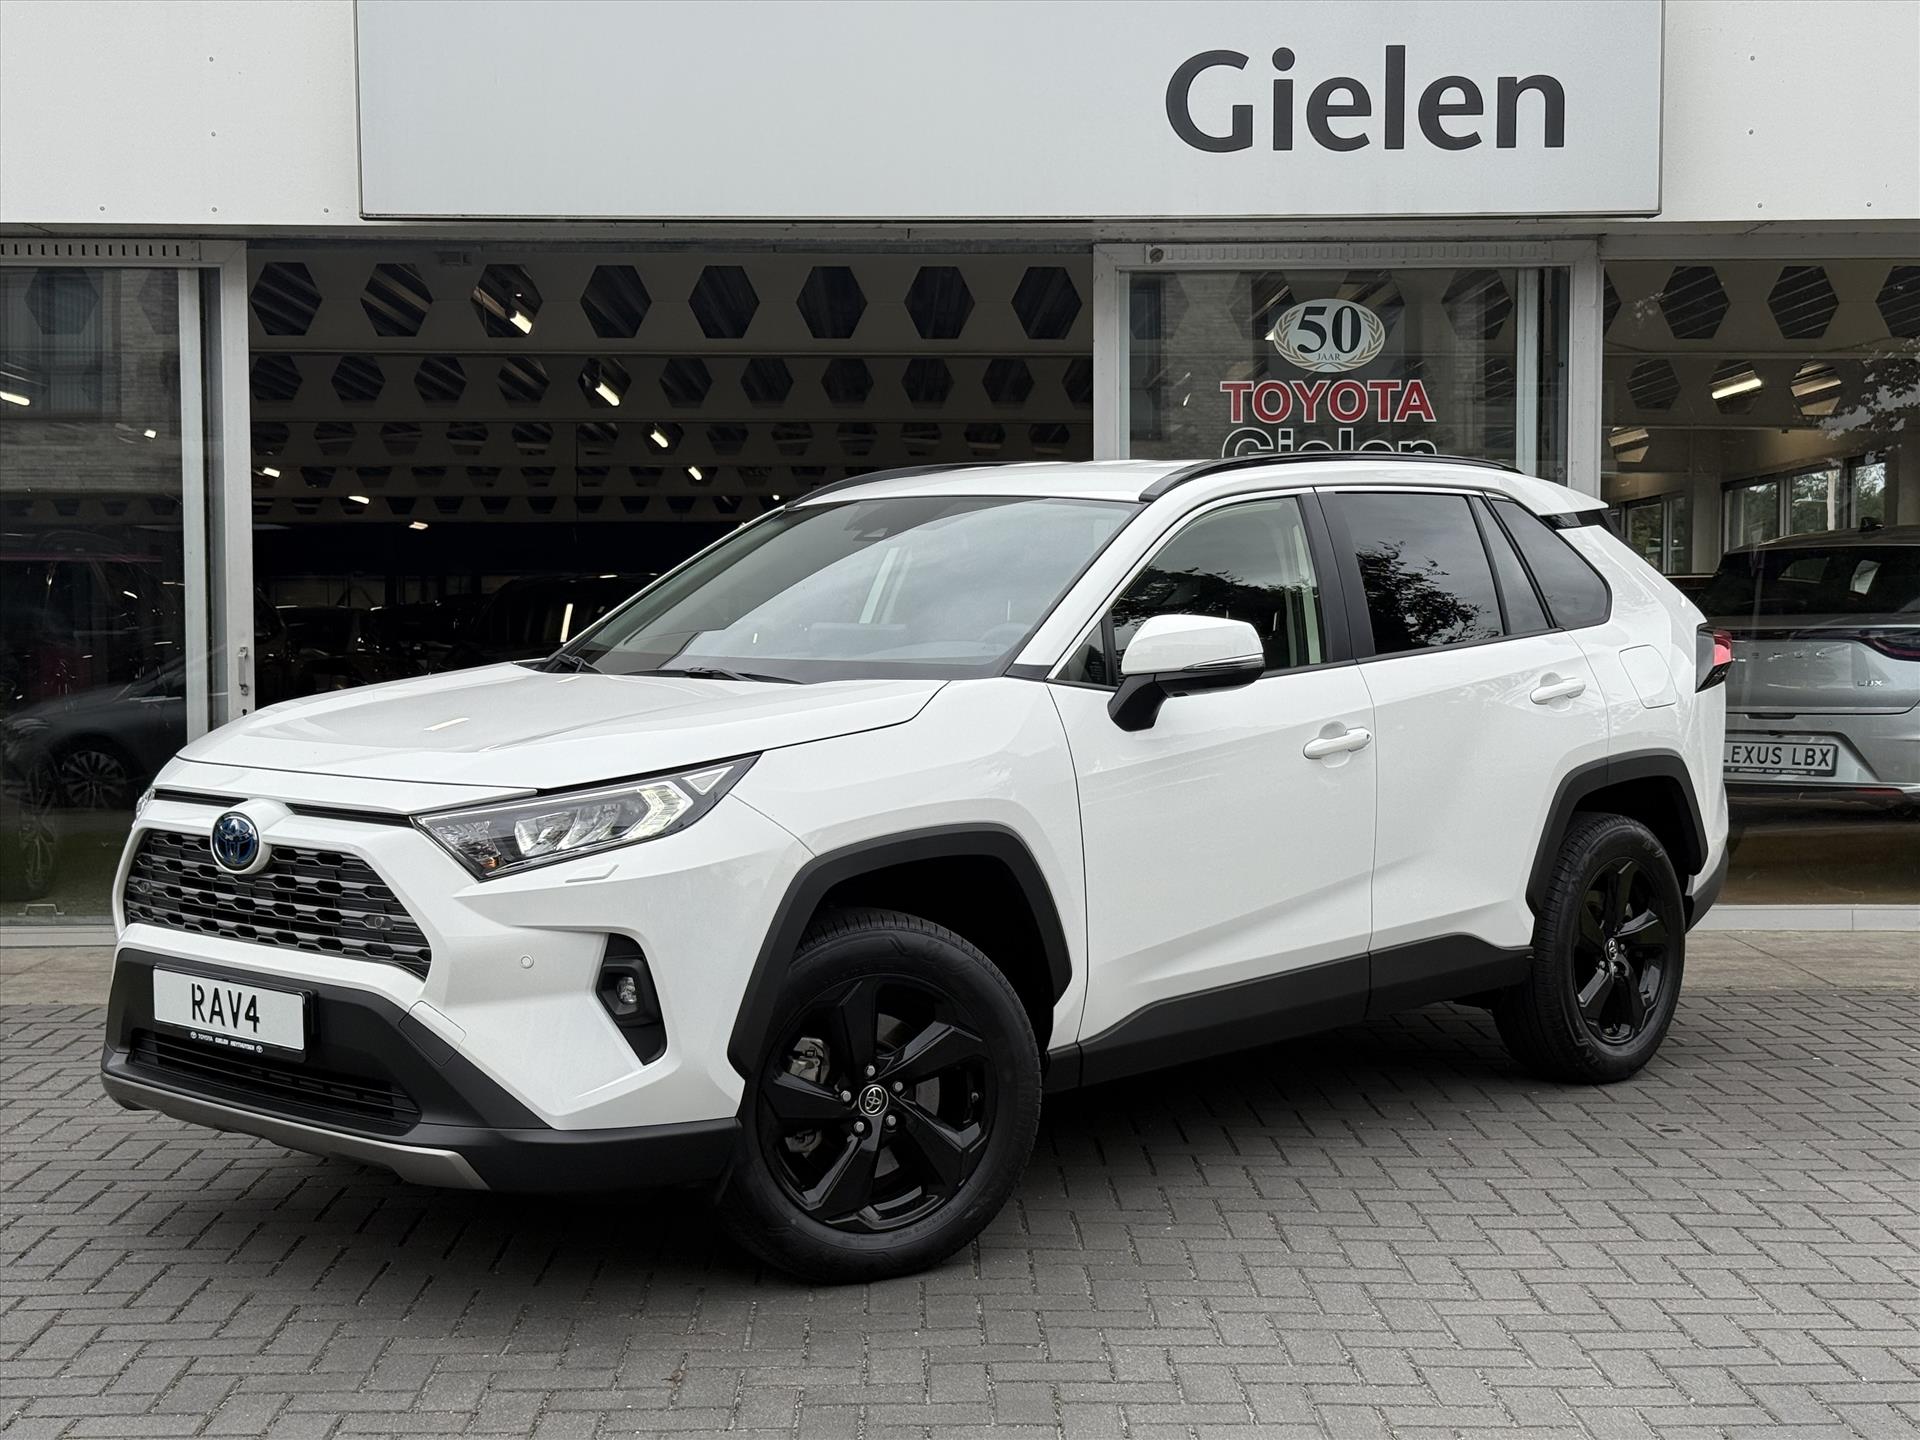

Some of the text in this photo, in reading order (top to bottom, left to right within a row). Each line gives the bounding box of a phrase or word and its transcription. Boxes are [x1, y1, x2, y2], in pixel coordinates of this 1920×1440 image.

[1166, 45, 1565, 153] Gielen
[1297, 305, 1362, 354] 50
[1316, 353, 1341, 362] JAAR
[1220, 379, 1437, 424] TOYOTA
[1791, 747, 1831, 767] LBX
[191, 983, 260, 1033] RAV4
